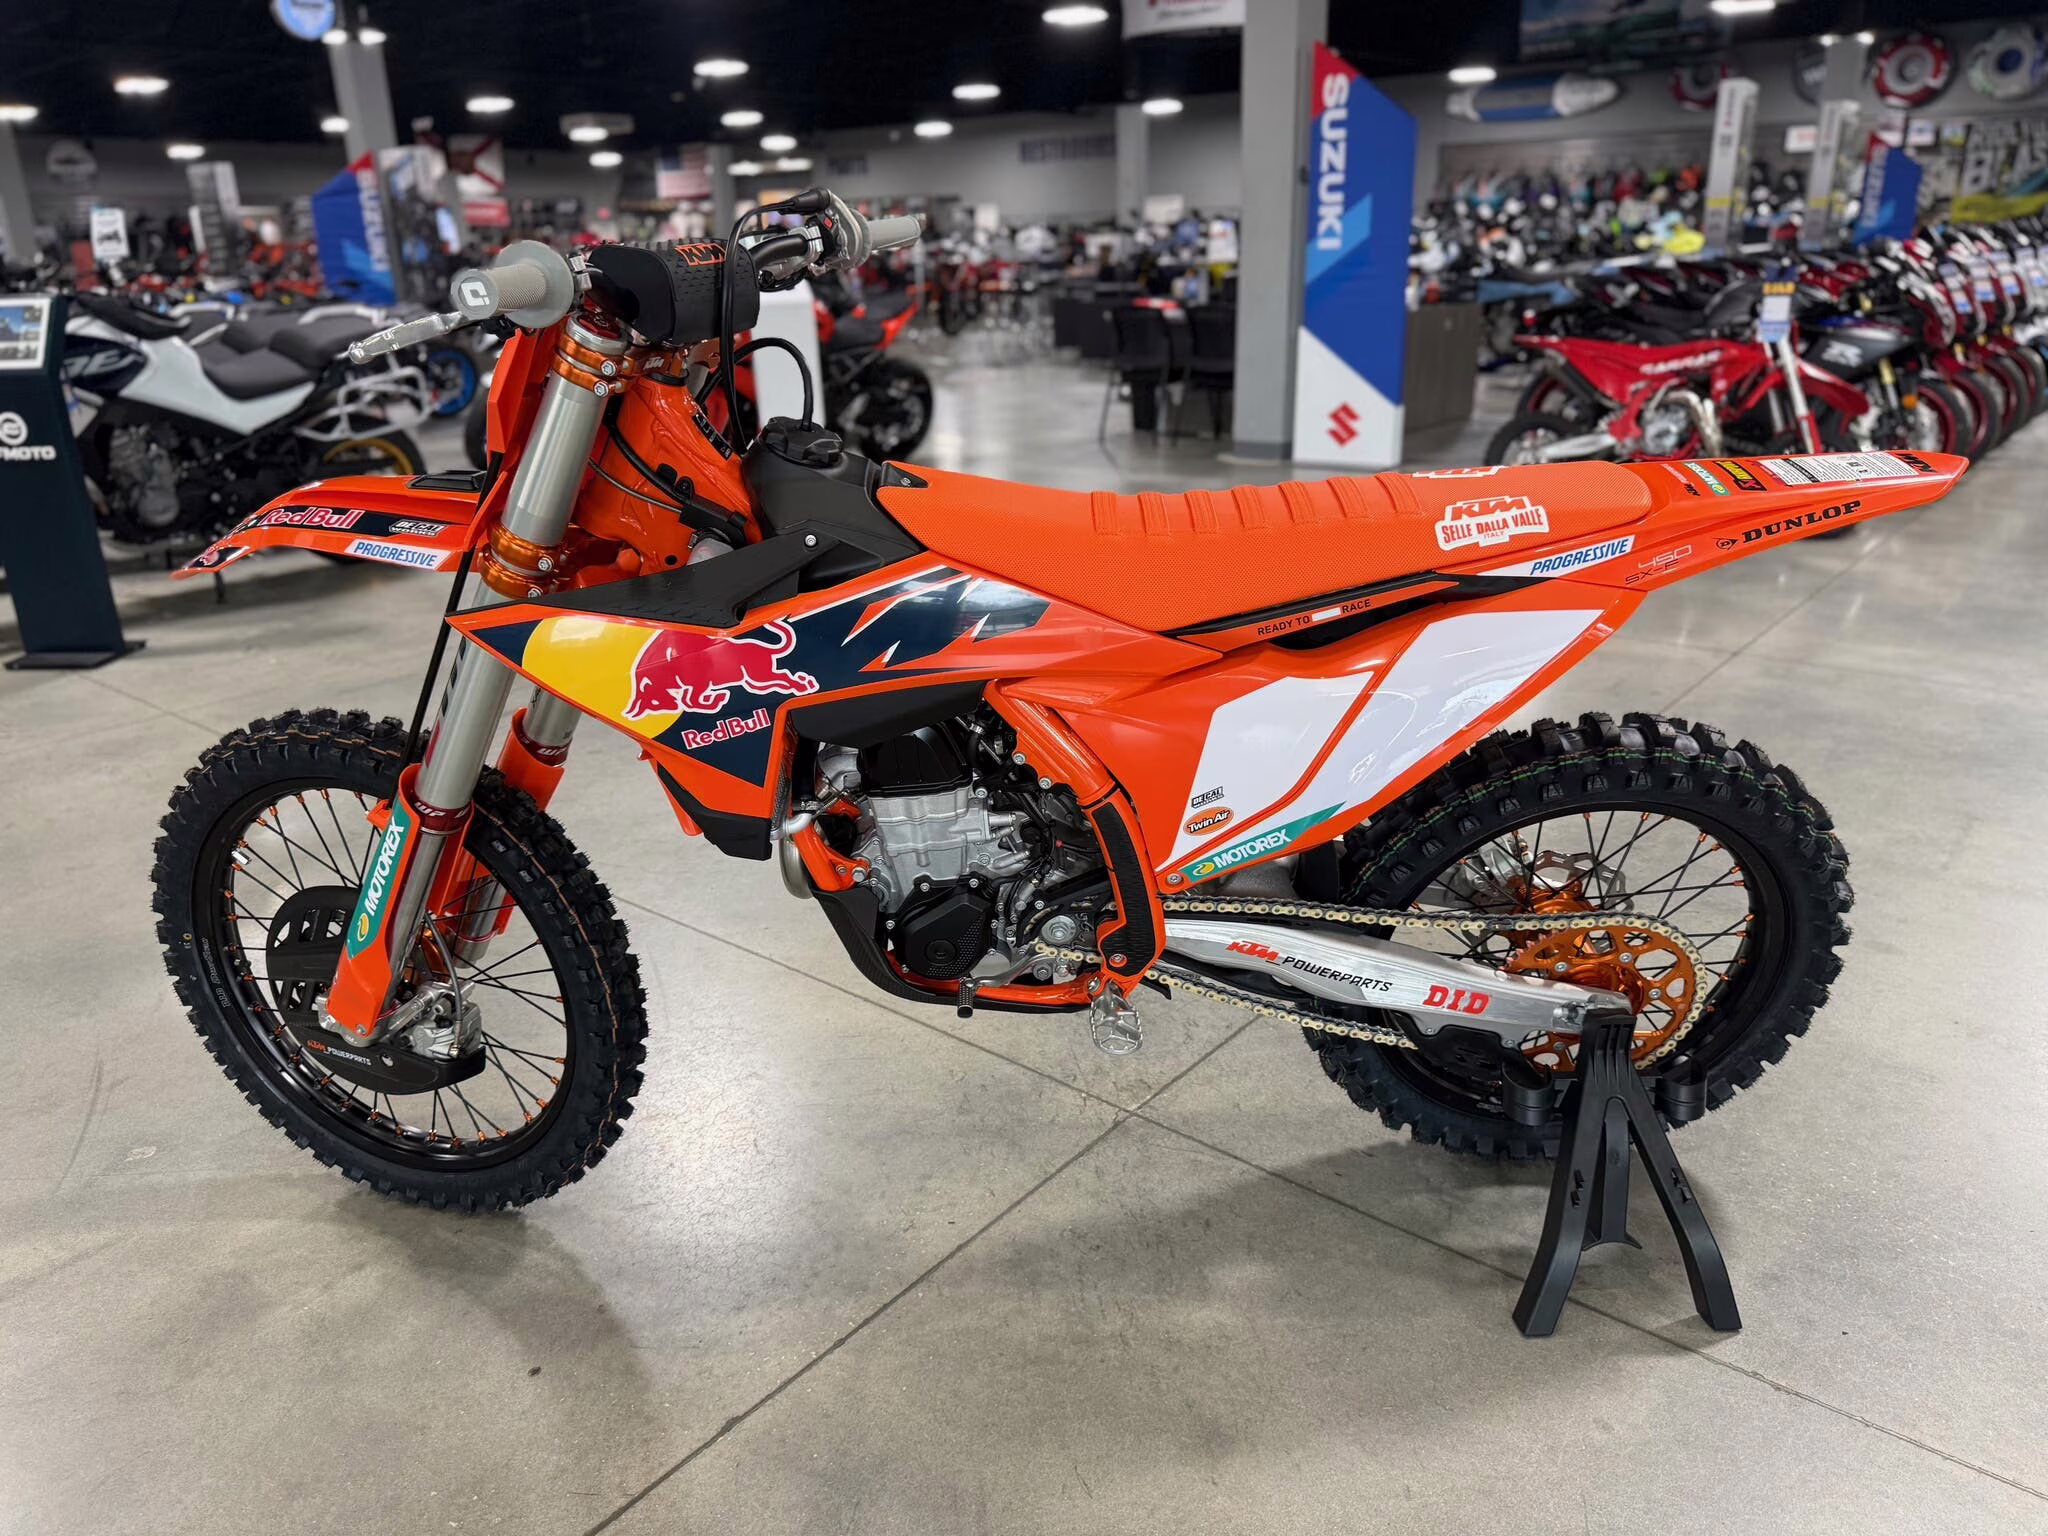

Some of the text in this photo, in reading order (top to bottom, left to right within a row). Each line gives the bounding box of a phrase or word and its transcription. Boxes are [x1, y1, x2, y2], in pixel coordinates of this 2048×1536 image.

[1316, 72, 1351, 250] SUZUKI
[674, 243, 727, 267] KTM
[642, 356, 665, 371] KTM
[257, 507, 365, 529] Red Bull
[1451, 496, 1527, 522] KTM
[1741, 499, 1862, 545] DUNLOP
[1441, 508, 1544, 544] SELLE DALLA VALLE
[1483, 531, 1505, 540] ITALY
[353, 541, 438, 568] PROGRESSIVE
[1530, 538, 1631, 576] PROGRESSIVE
[1638, 544, 1692, 569] 450
[1624, 559, 1680, 586] SX-F
[1257, 598, 1372, 636] READY TO RACE
[681, 707, 772, 750] Red Bull
[1187, 809, 1231, 834] Twin Air
[1212, 828, 1293, 868] MOTOREX
[364, 815, 405, 917] MOTOREX
[1224, 940, 1394, 992] KTM POWERPARTS
